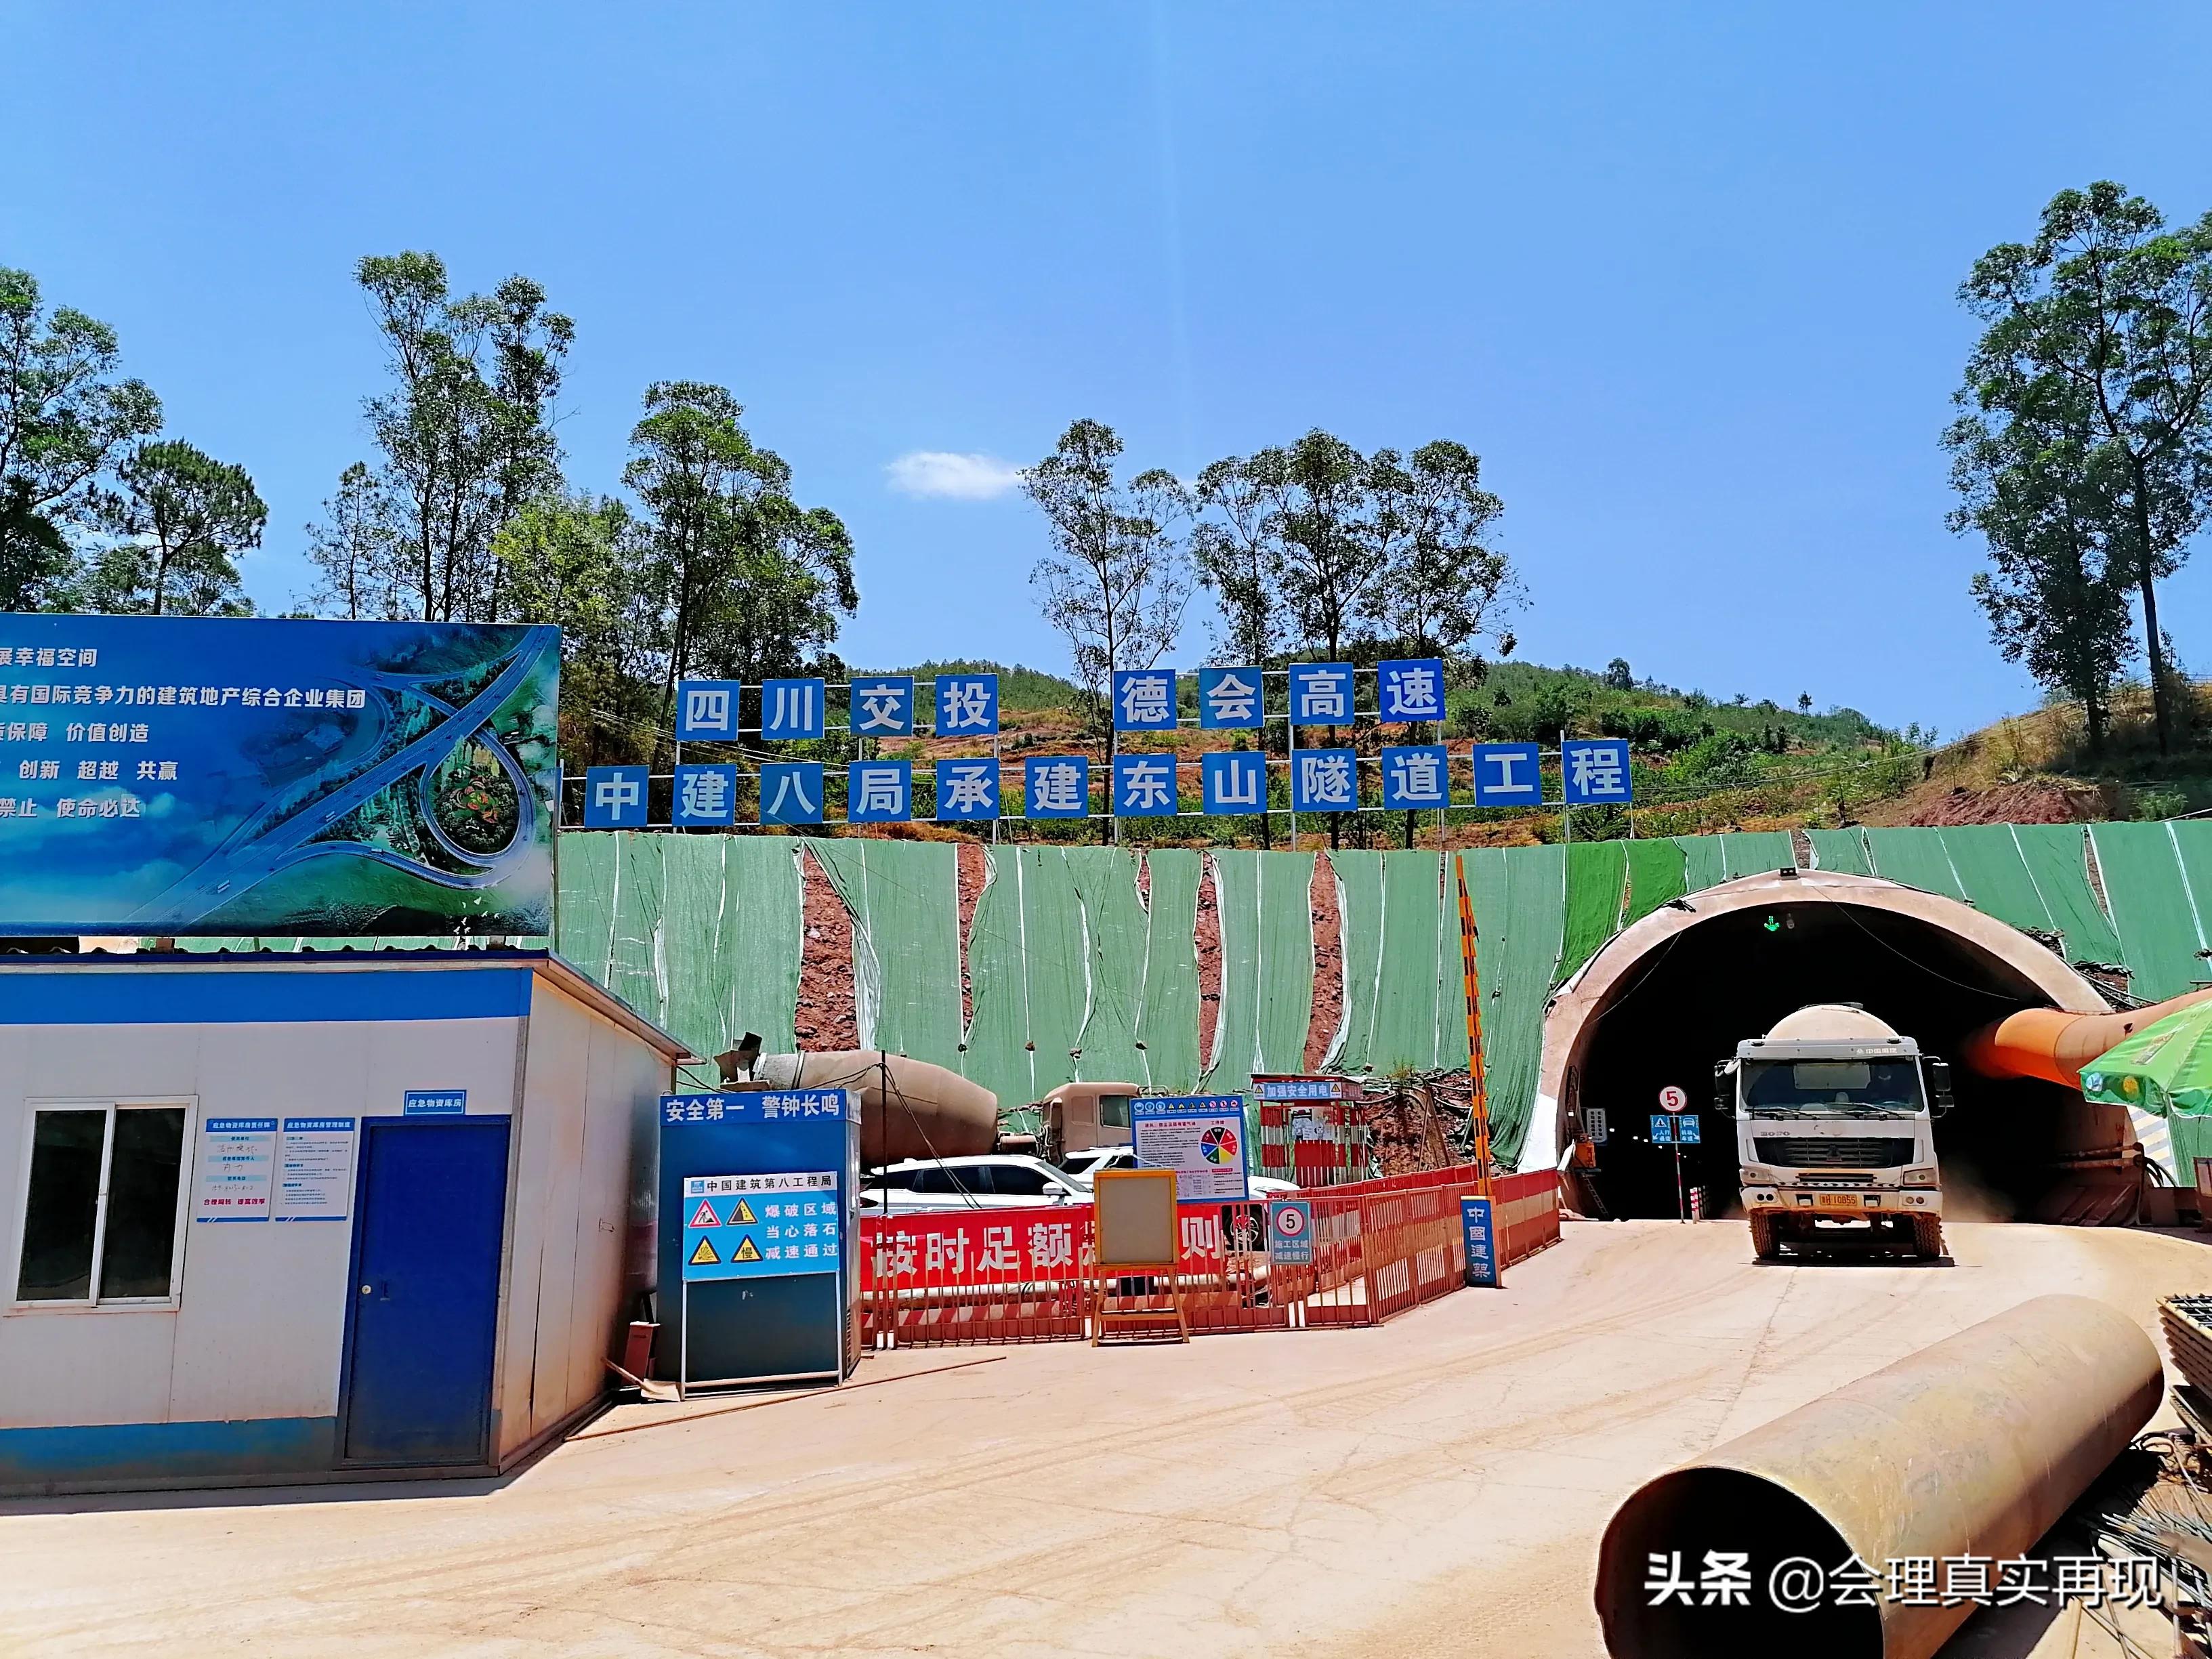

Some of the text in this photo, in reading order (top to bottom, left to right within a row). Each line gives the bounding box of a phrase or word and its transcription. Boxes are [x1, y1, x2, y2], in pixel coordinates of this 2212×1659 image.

[1121, 667, 1439, 723] 德会高速
[686, 681, 992, 732] 四川交投
[66, 722, 149, 742] 价值创造
[19, 759, 178, 780] 创新 超越 共赢
[593, 747, 1624, 821] 中建八局承建东山隧道工程
[0, 798, 141, 818] 禁止 使命必达
[1266, 1085, 1328, 1097] 加强安全用电
[1666, 1091, 1679, 1106] 5
[408, 1098, 462, 1108] 应急物资库房
[666, 1093, 839, 1122] 安全第一 警钟长鸣
[707, 1175, 832, 1192] 中国建筑第八工程局
[765, 1201, 837, 1218] 爆破区域
[1286, 1213, 1295, 1229] 5
[766, 1222, 837, 1239] 当心落石
[741, 1246, 753, 1259] 慢
[765, 1243, 838, 1260] 减速通过
